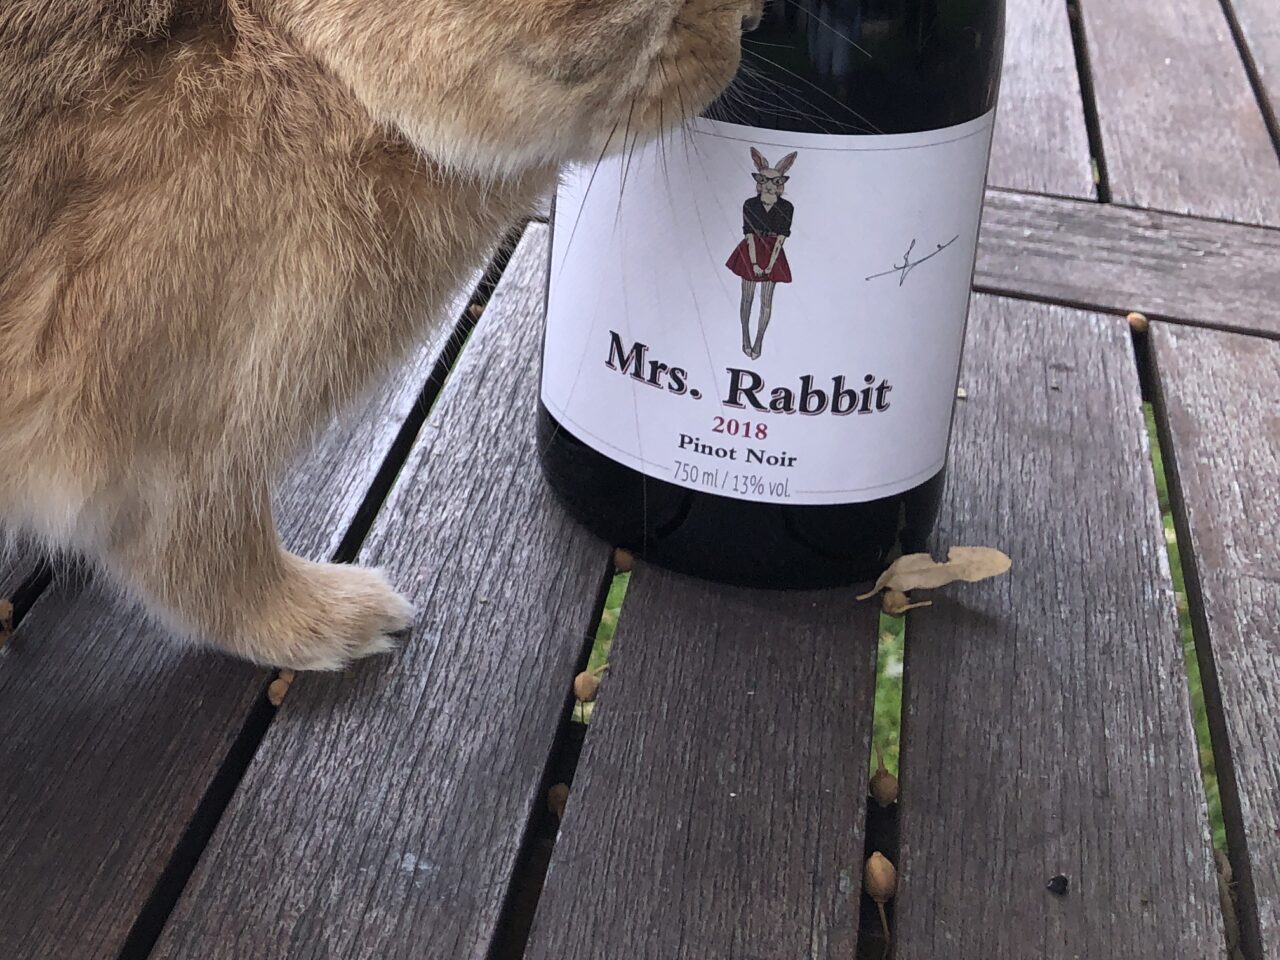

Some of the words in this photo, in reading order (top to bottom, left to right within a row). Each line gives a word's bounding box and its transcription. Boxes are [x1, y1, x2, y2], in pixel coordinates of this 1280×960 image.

[604, 329, 703, 400] Mrs.
[722, 366, 893, 416] Rabbit
[711, 415, 769, 440] 2018
[678, 433, 737, 461] Pinot
[745, 447, 797, 468] Noir
[673, 460, 699, 483] 750
[701, 469, 719, 489] ml
[732, 474, 765, 495] 13%
[769, 476, 791, 498] vol.
